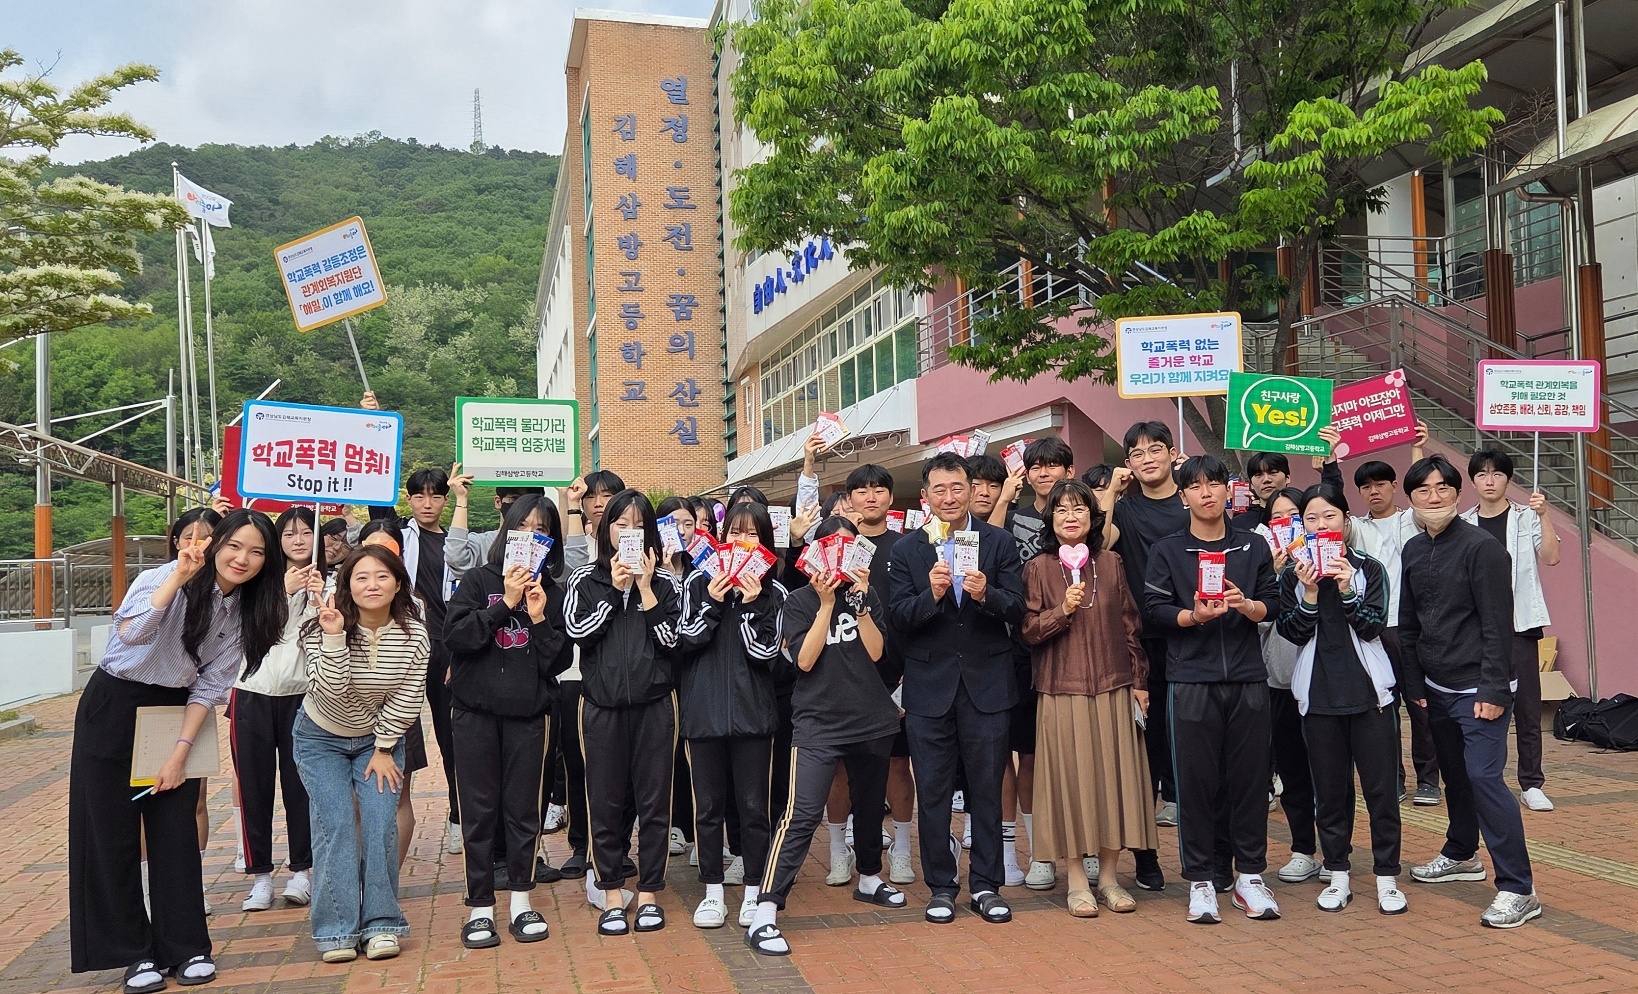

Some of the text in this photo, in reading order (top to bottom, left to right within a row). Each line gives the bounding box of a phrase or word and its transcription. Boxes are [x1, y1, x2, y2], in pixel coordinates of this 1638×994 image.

[286, 262, 322, 283] 학교폭력
[322, 244, 367, 272] 갈등조정은
[612, 113, 647, 401] 김해삼방고등학교
[301, 265, 363, 298] 관계회복지원단
[333, 288, 353, 306] 함께
[353, 280, 375, 298] 해요!
[1141, 338, 1220, 353] 학교폭력 없는
[1148, 354, 1214, 369] 즐거운 학교
[1130, 368, 1233, 385] 우리가 함께 지켜요
[1500, 380, 1578, 390] 학교폭력 관계회복을
[1260, 389, 1301, 403] 친구사랑
[1358, 388, 1401, 408] 아프잖아
[1511, 391, 1566, 401] 위해 필요한 것
[668, 377, 701, 445] 산실
[1251, 402, 1308, 427] Yes!
[1363, 403, 1406, 423] 이제그만
[1489, 403, 1586, 416] 상호존중, 배려, 신뢰, 공감, 책임
[471, 416, 566, 433] 학교폭력 물러가라
[1368, 426, 1410, 443] 김해삼방고등학교
[471, 436, 566, 453] 학교폭력 엄중처벌
[1285, 443, 1325, 452] 김해삼방고등학교
[252, 438, 390, 475] 학교폭력 멈춰!
[495, 470, 544, 478] 김해삼방고등학교
[287, 473, 353, 495] Stop it !!
